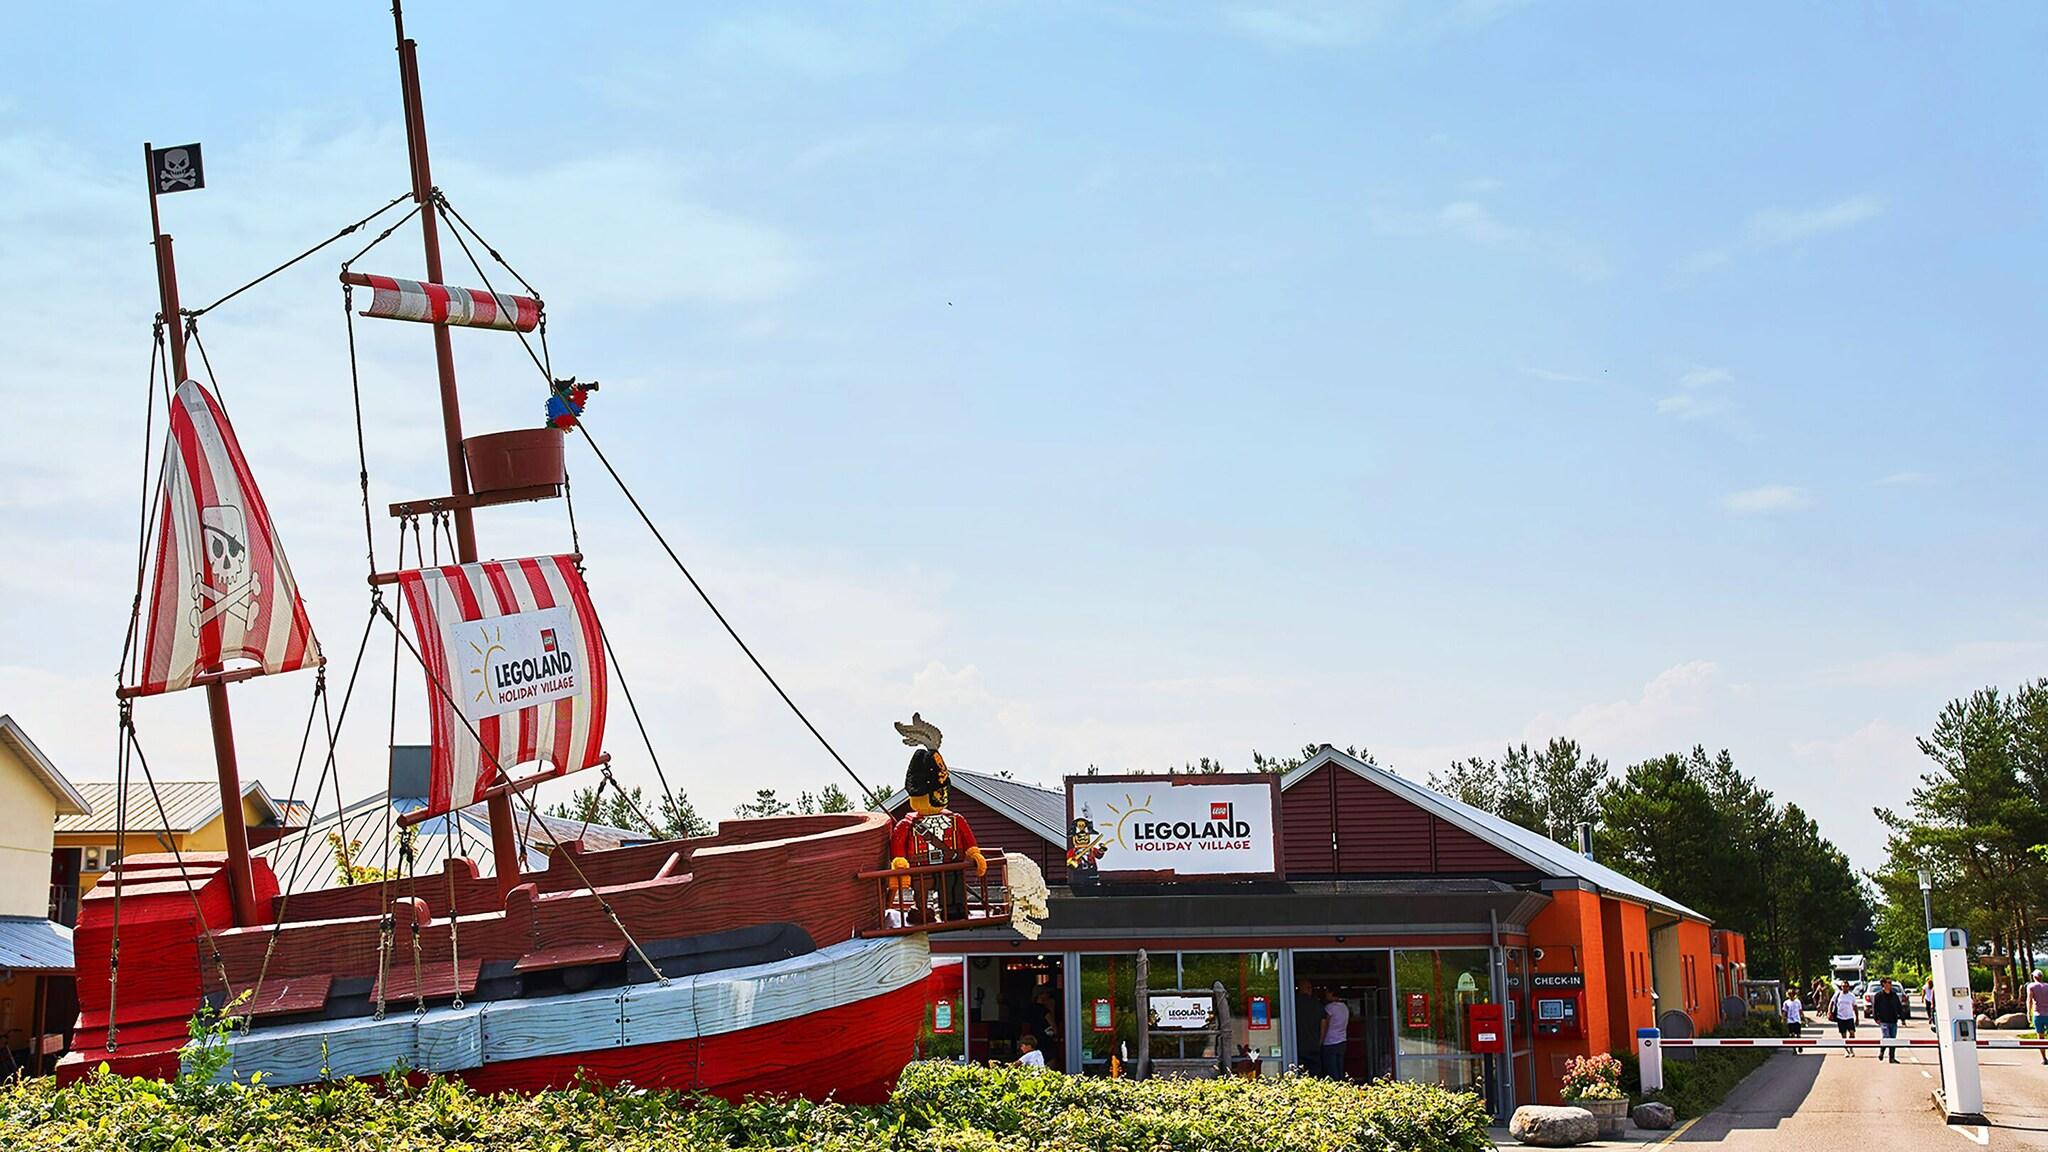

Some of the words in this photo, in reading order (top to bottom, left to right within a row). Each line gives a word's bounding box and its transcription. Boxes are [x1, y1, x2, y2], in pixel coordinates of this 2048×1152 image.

[495, 628, 573, 688] LEGOLAND
[498, 684, 538, 704] HOLIDAY
[540, 676, 575, 695] VILLAGE
[1134, 803, 1250, 840] LEGOLAND
[1135, 842, 1192, 851] HOLIDAY
[1199, 841, 1251, 850] VILLAGE
[1534, 976, 1580, 985] CHECK-IN
